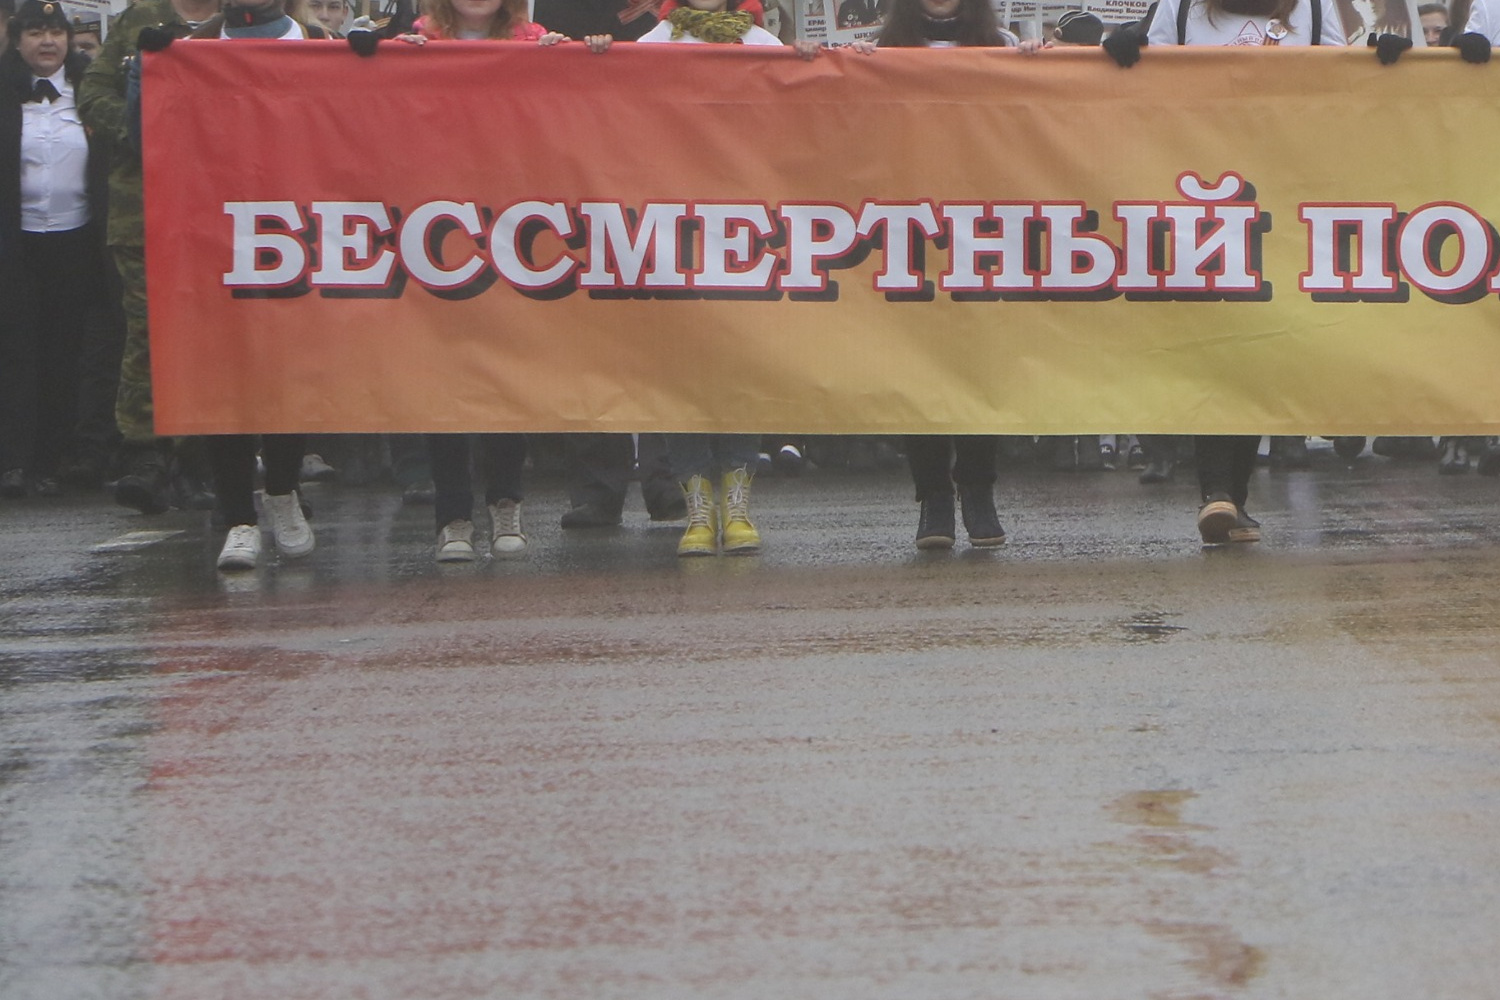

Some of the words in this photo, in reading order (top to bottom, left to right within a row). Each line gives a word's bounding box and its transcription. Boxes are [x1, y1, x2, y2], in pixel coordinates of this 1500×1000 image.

[1105, 0, 1147, 8] КЛОЧКОВ
[1087, 5, 1124, 14] Владимир
[220, 171, 1264, 297] БЕССМЕРТНЫЙ
